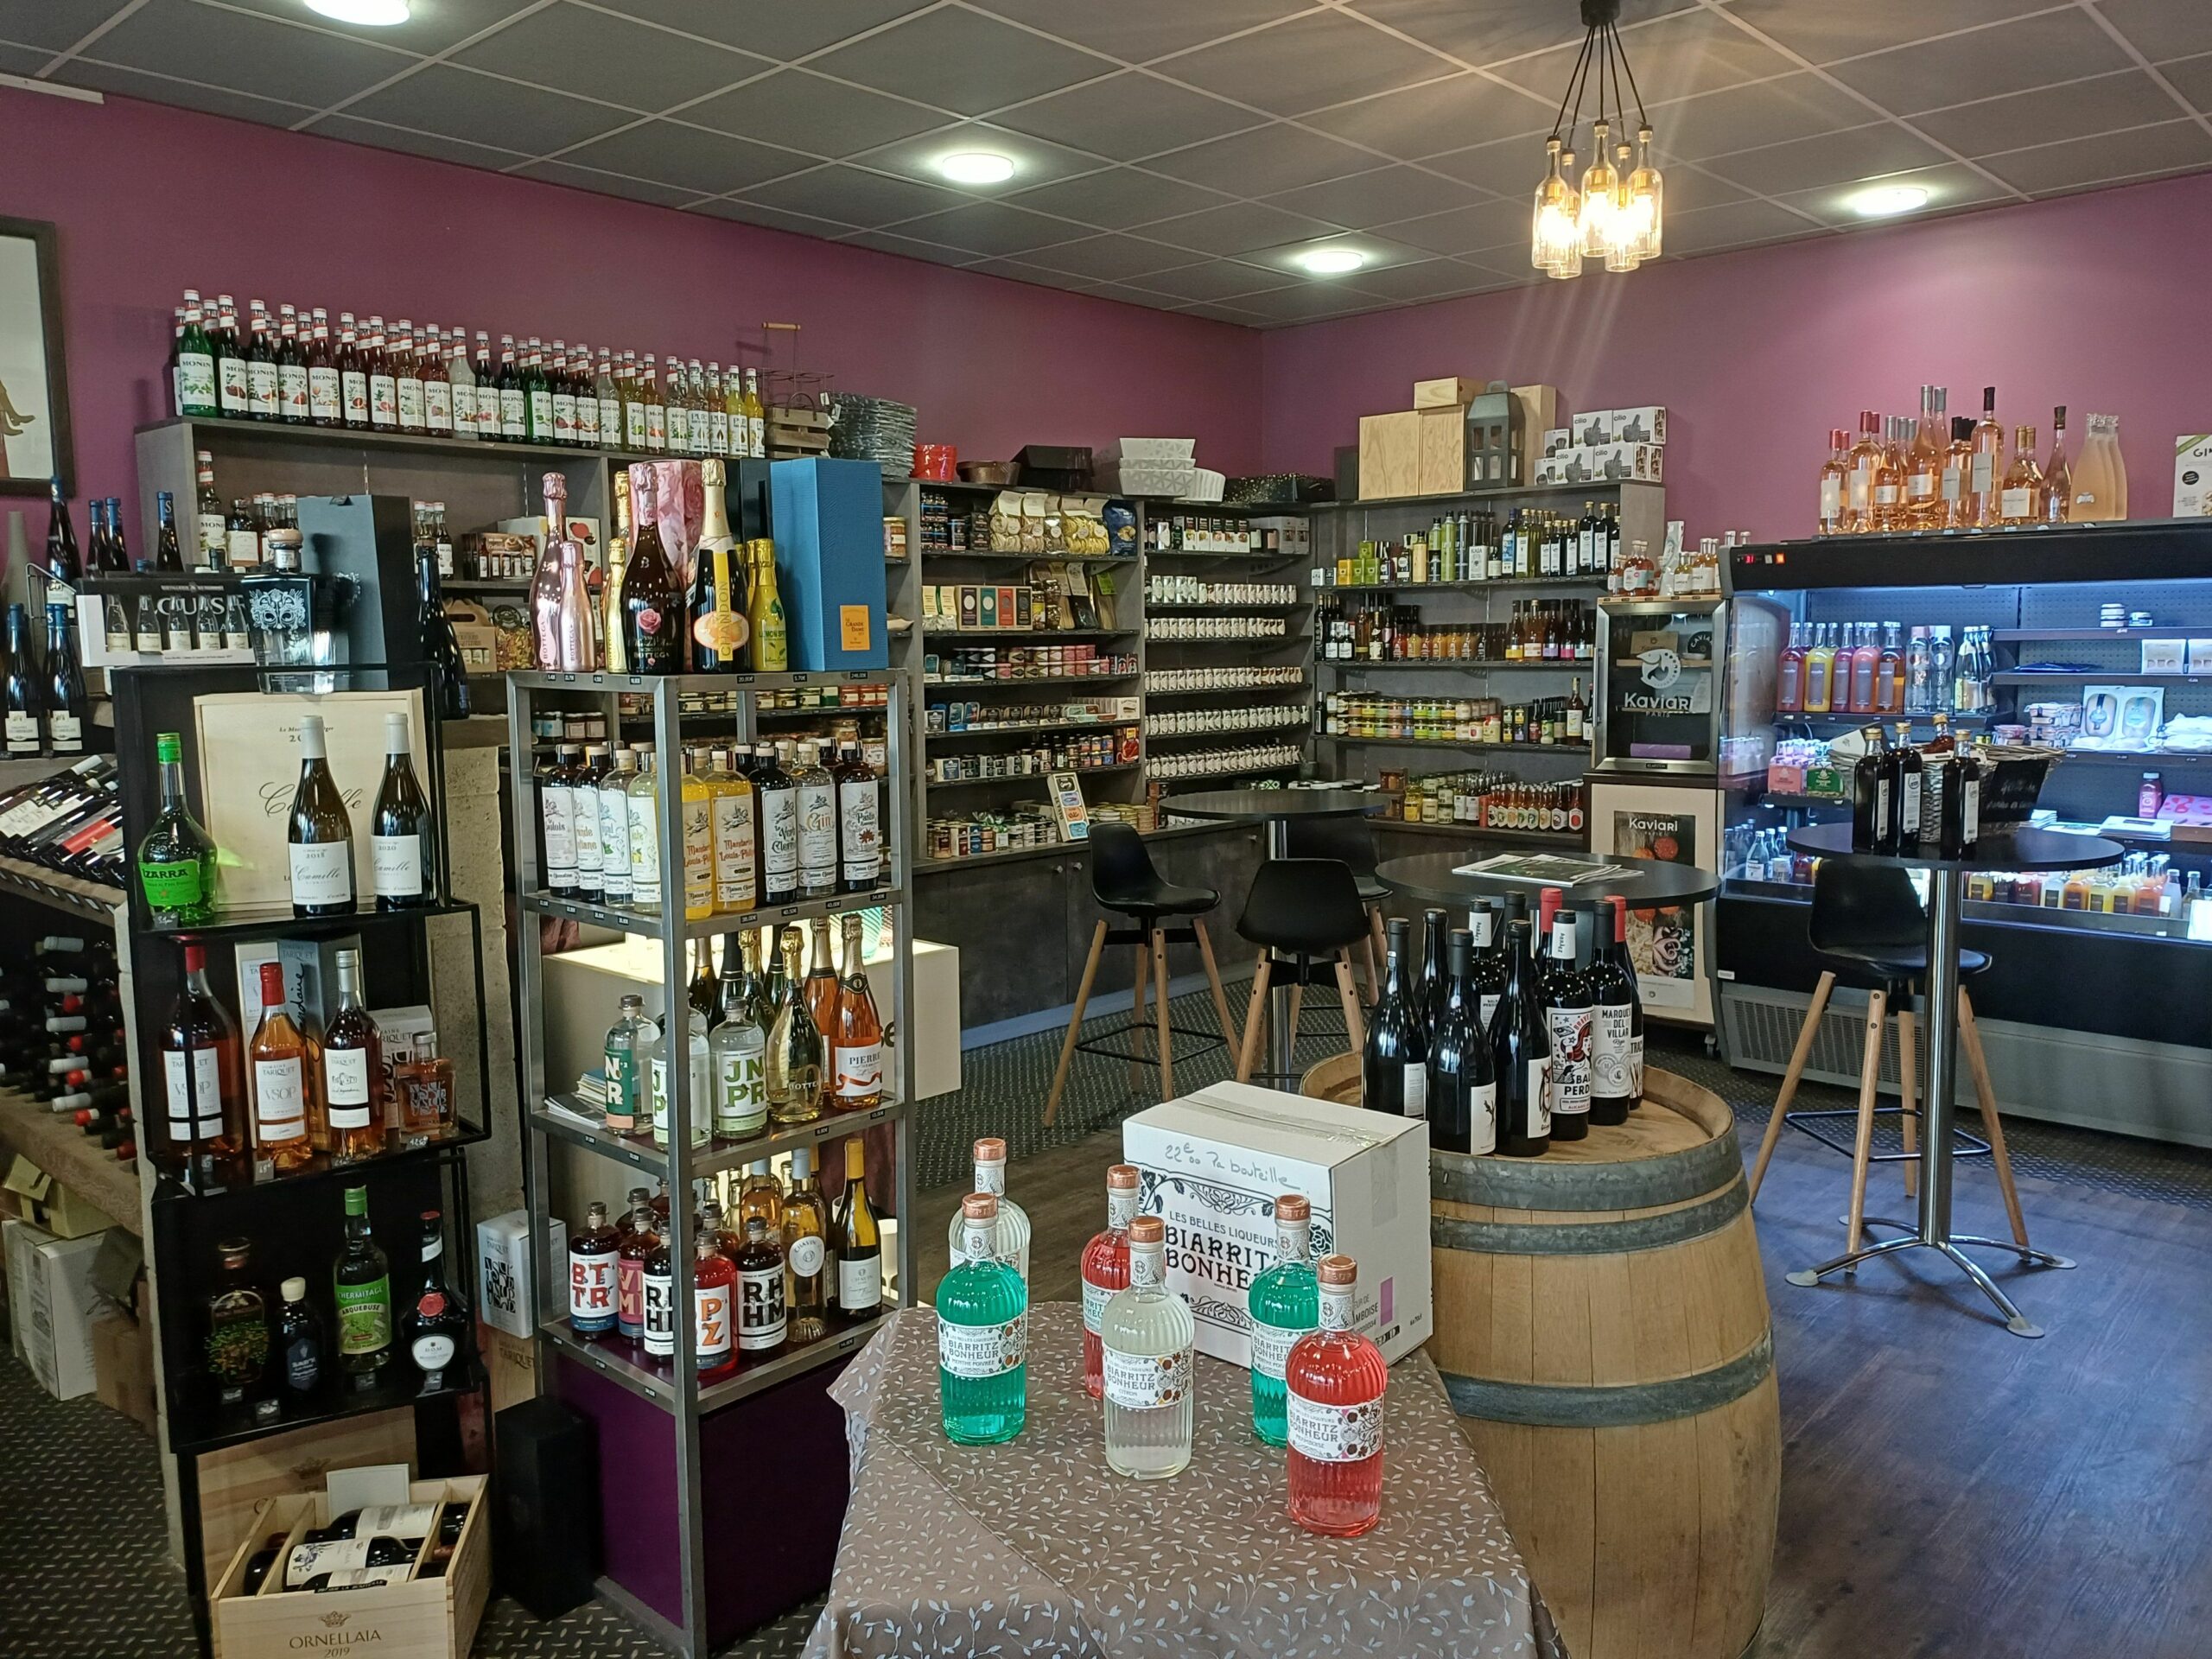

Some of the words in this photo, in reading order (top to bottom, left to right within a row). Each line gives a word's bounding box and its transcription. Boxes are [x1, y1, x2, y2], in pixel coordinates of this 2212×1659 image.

[181, 359, 211, 368] MONIN
[247, 368, 275, 377] MONIN
[718, 581, 731, 657] CHANDON
[1690, 634, 1713, 648] CAVIA
[143, 868, 188, 879] IZARRA
[296, 864, 341, 880] Camille
[1602, 1008, 1631, 1019] MARQUES
[1613, 1019, 1625, 1028] DEL
[1607, 1027, 1629, 1039] VILLAR
[263, 1066, 296, 1077] TARIQUET
[789, 1081, 818, 1090] BOTTE
[1564, 1085, 1590, 1096] PERD
[264, 1087, 296, 1101] VSOP
[1230, 1159, 1300, 1191] bouteille
[1169, 1211, 1187, 1224] LES
[1190, 1217, 1227, 1235] BELLES
[1166, 1224, 1277, 1271] BIARRIT
[1166, 1247, 1254, 1291] BONHE
[1353, 1301, 1378, 1325] MBOISE
[948, 1340, 999, 1351] BIARRITZ
[1254, 1337, 1290, 1353] BIARRIT
[499, 1347, 534, 1370] TARIQUE
[949, 1349, 999, 1359] BONHEUR
[1254, 1344, 1287, 1363] BONHEU
[1108, 1364, 1155, 1382] BIARRITZ
[1108, 1373, 1155, 1390] BONHEUR
[1290, 1409, 1338, 1433] BIARRITZ
[1290, 1418, 1338, 1442] BONHEUR
[289, 1630, 382, 1649] ORNELLAIA
[324, 1647, 351, 1659] 2019
